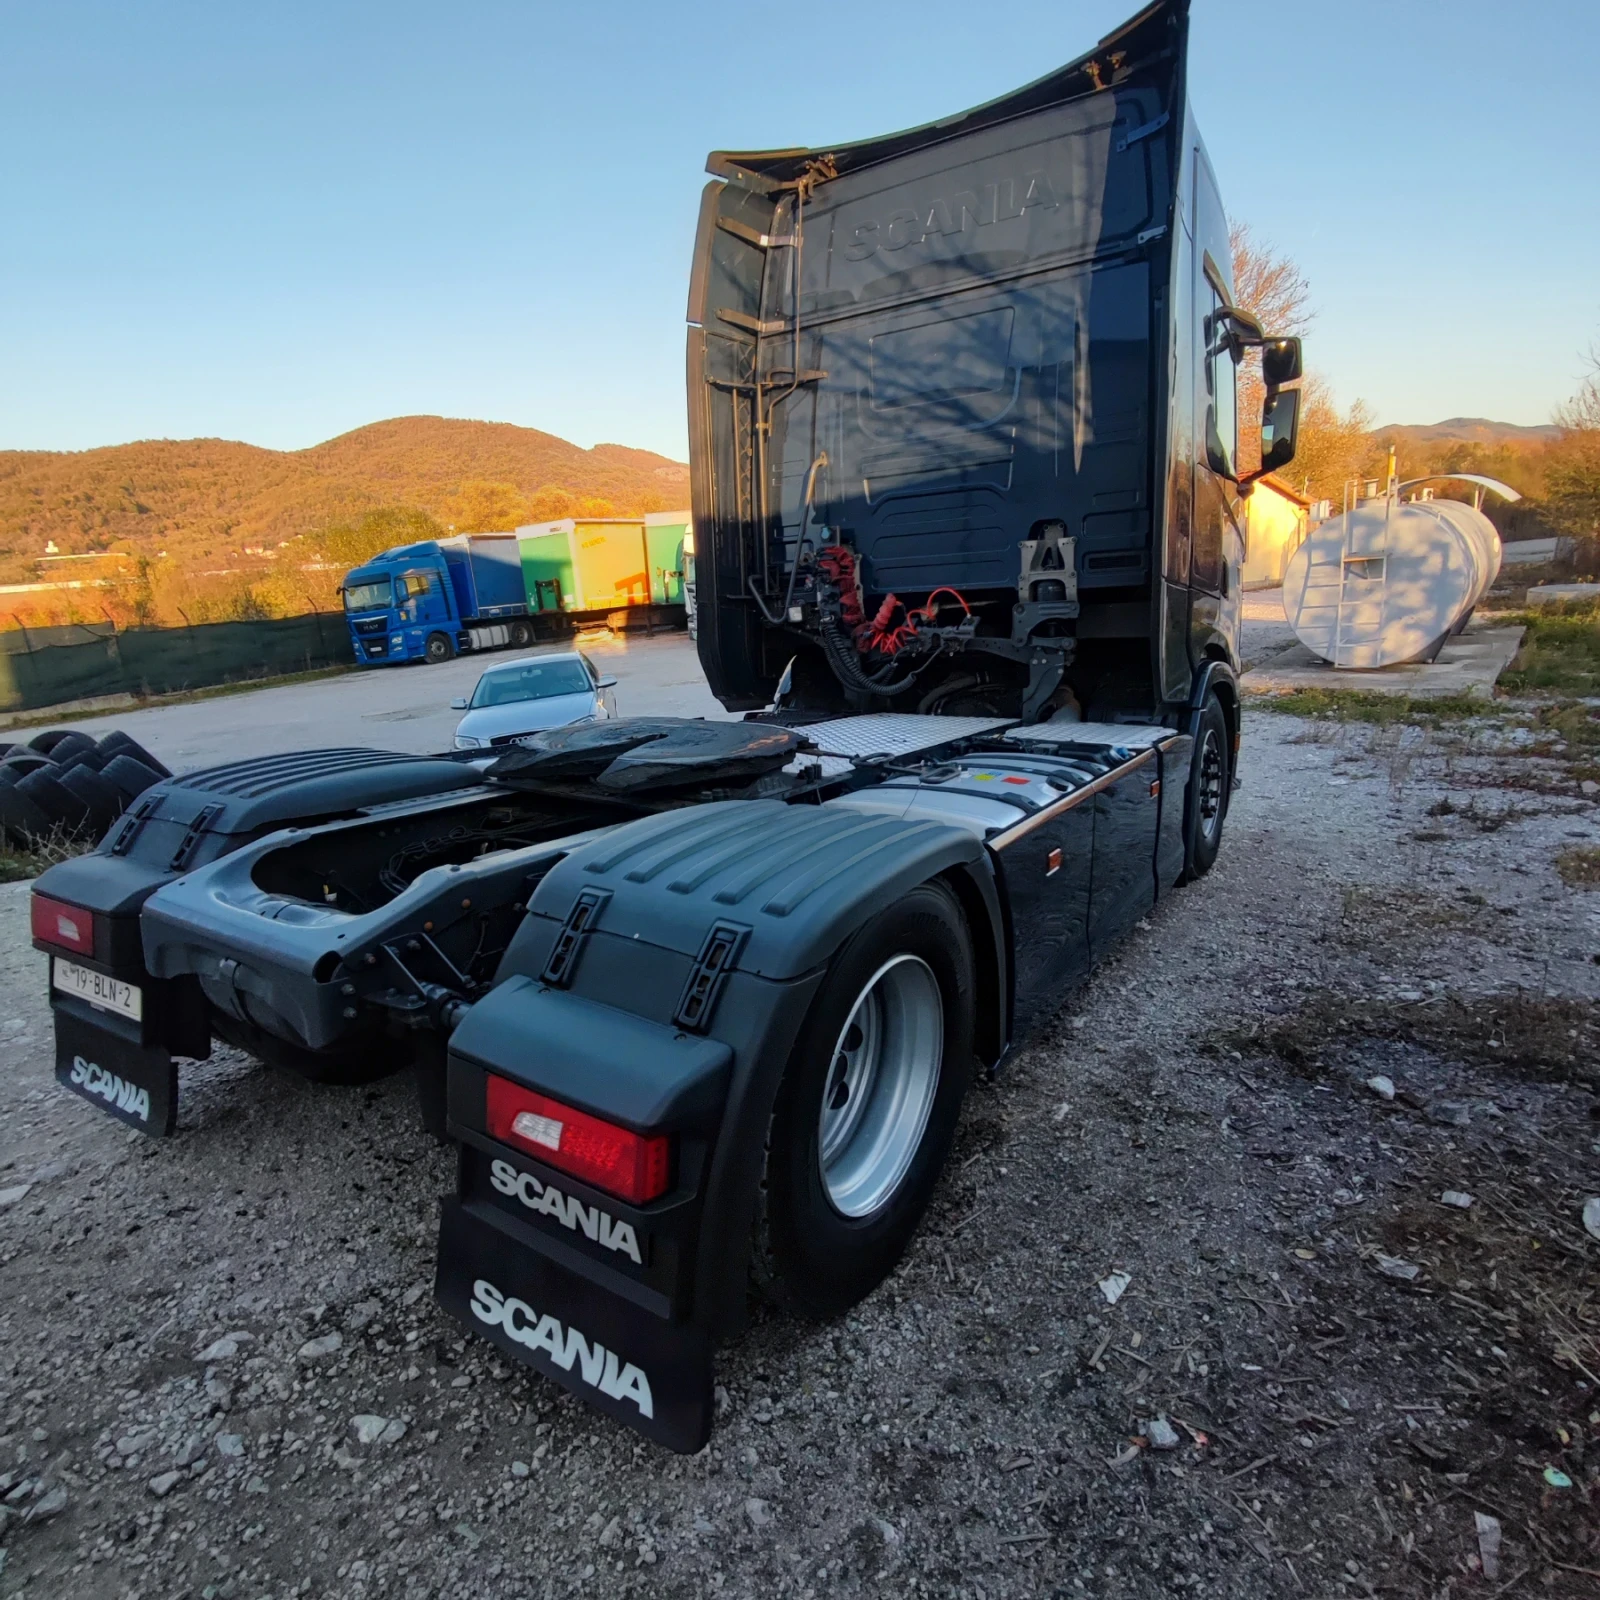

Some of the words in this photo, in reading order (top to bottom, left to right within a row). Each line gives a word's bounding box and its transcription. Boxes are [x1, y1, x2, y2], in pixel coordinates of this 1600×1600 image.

[845, 169, 1059, 261] SCANIA
[70, 1055, 150, 1121] SCANIA
[490, 1159, 642, 1264] SCANIA
[470, 1279, 654, 1420] SCANIA
